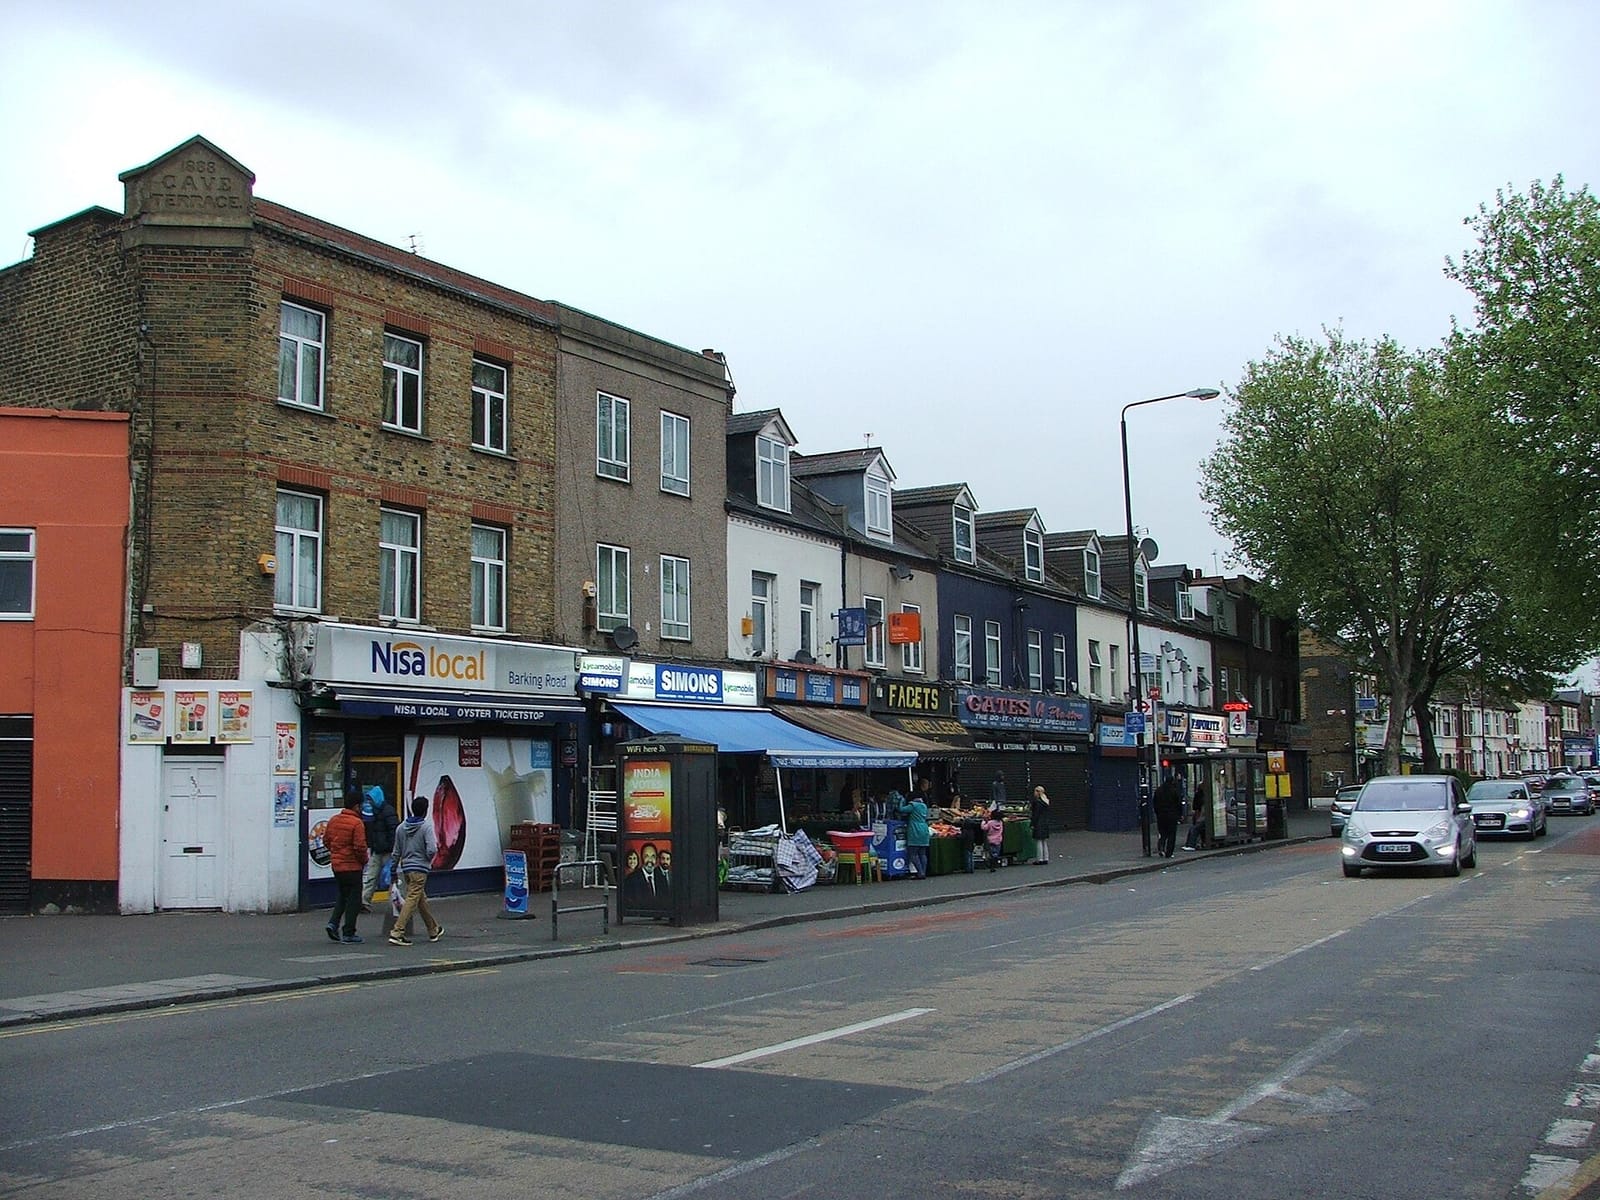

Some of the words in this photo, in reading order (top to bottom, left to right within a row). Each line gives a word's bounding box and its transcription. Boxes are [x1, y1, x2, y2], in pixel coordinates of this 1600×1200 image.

[162, 175, 232, 191] CAVE
[371, 640, 425, 676] Nisa
[429, 646, 485, 680] local
[582, 660, 622, 672] Lycamobile
[508, 671, 543, 689] Barking
[546, 674, 567, 688] Road
[582, 676, 619, 688] SIMONS
[629, 675, 655, 686] amobile
[661, 670, 718, 694] SIMONS
[724, 682, 755, 694] Lycamobile
[889, 684, 939, 710] FACETS
[394, 704, 416, 714] NISA
[420, 706, 450, 716] LOCAL
[457, 708, 491, 718] OYSTER
[494, 709, 544, 720] TICKETSTOP
[966, 695, 1032, 716] GATES
[975, 713, 988, 721] THE
[626, 745, 641, 753] WiFi
[633, 768, 660, 778] INDIA
